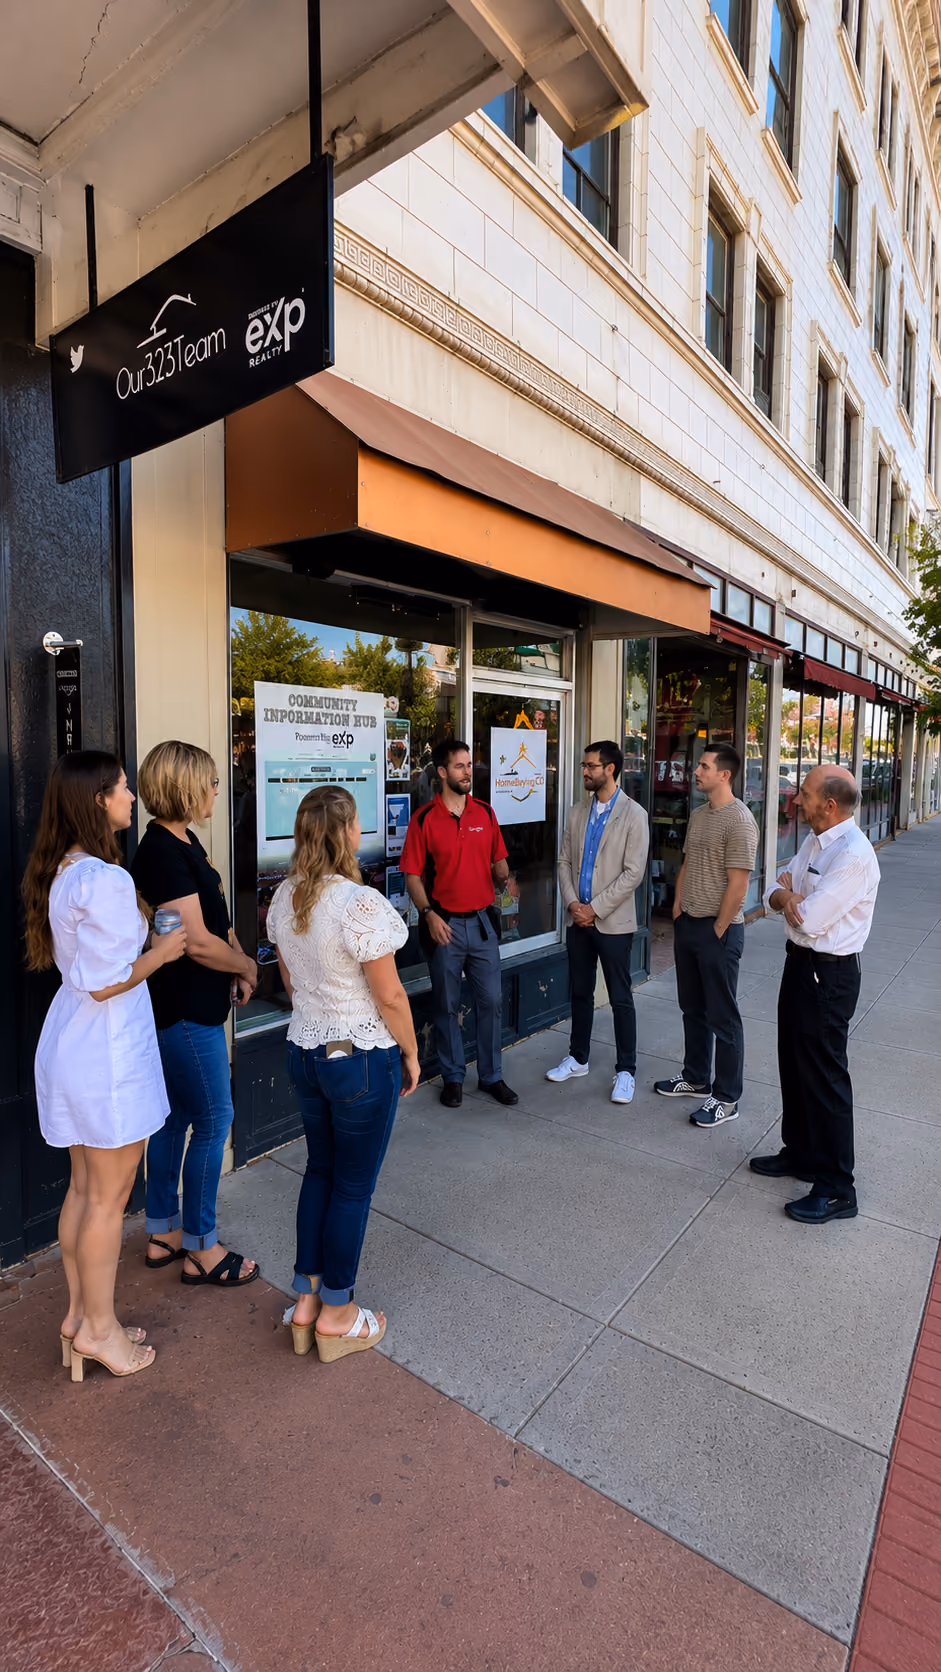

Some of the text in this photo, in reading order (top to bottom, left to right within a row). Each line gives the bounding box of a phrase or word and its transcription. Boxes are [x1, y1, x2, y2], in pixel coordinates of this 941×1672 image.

[116, 327, 226, 400] Our323Team
[248, 344, 283, 368] REALTY
[288, 693, 358, 712] COMMUNITY
